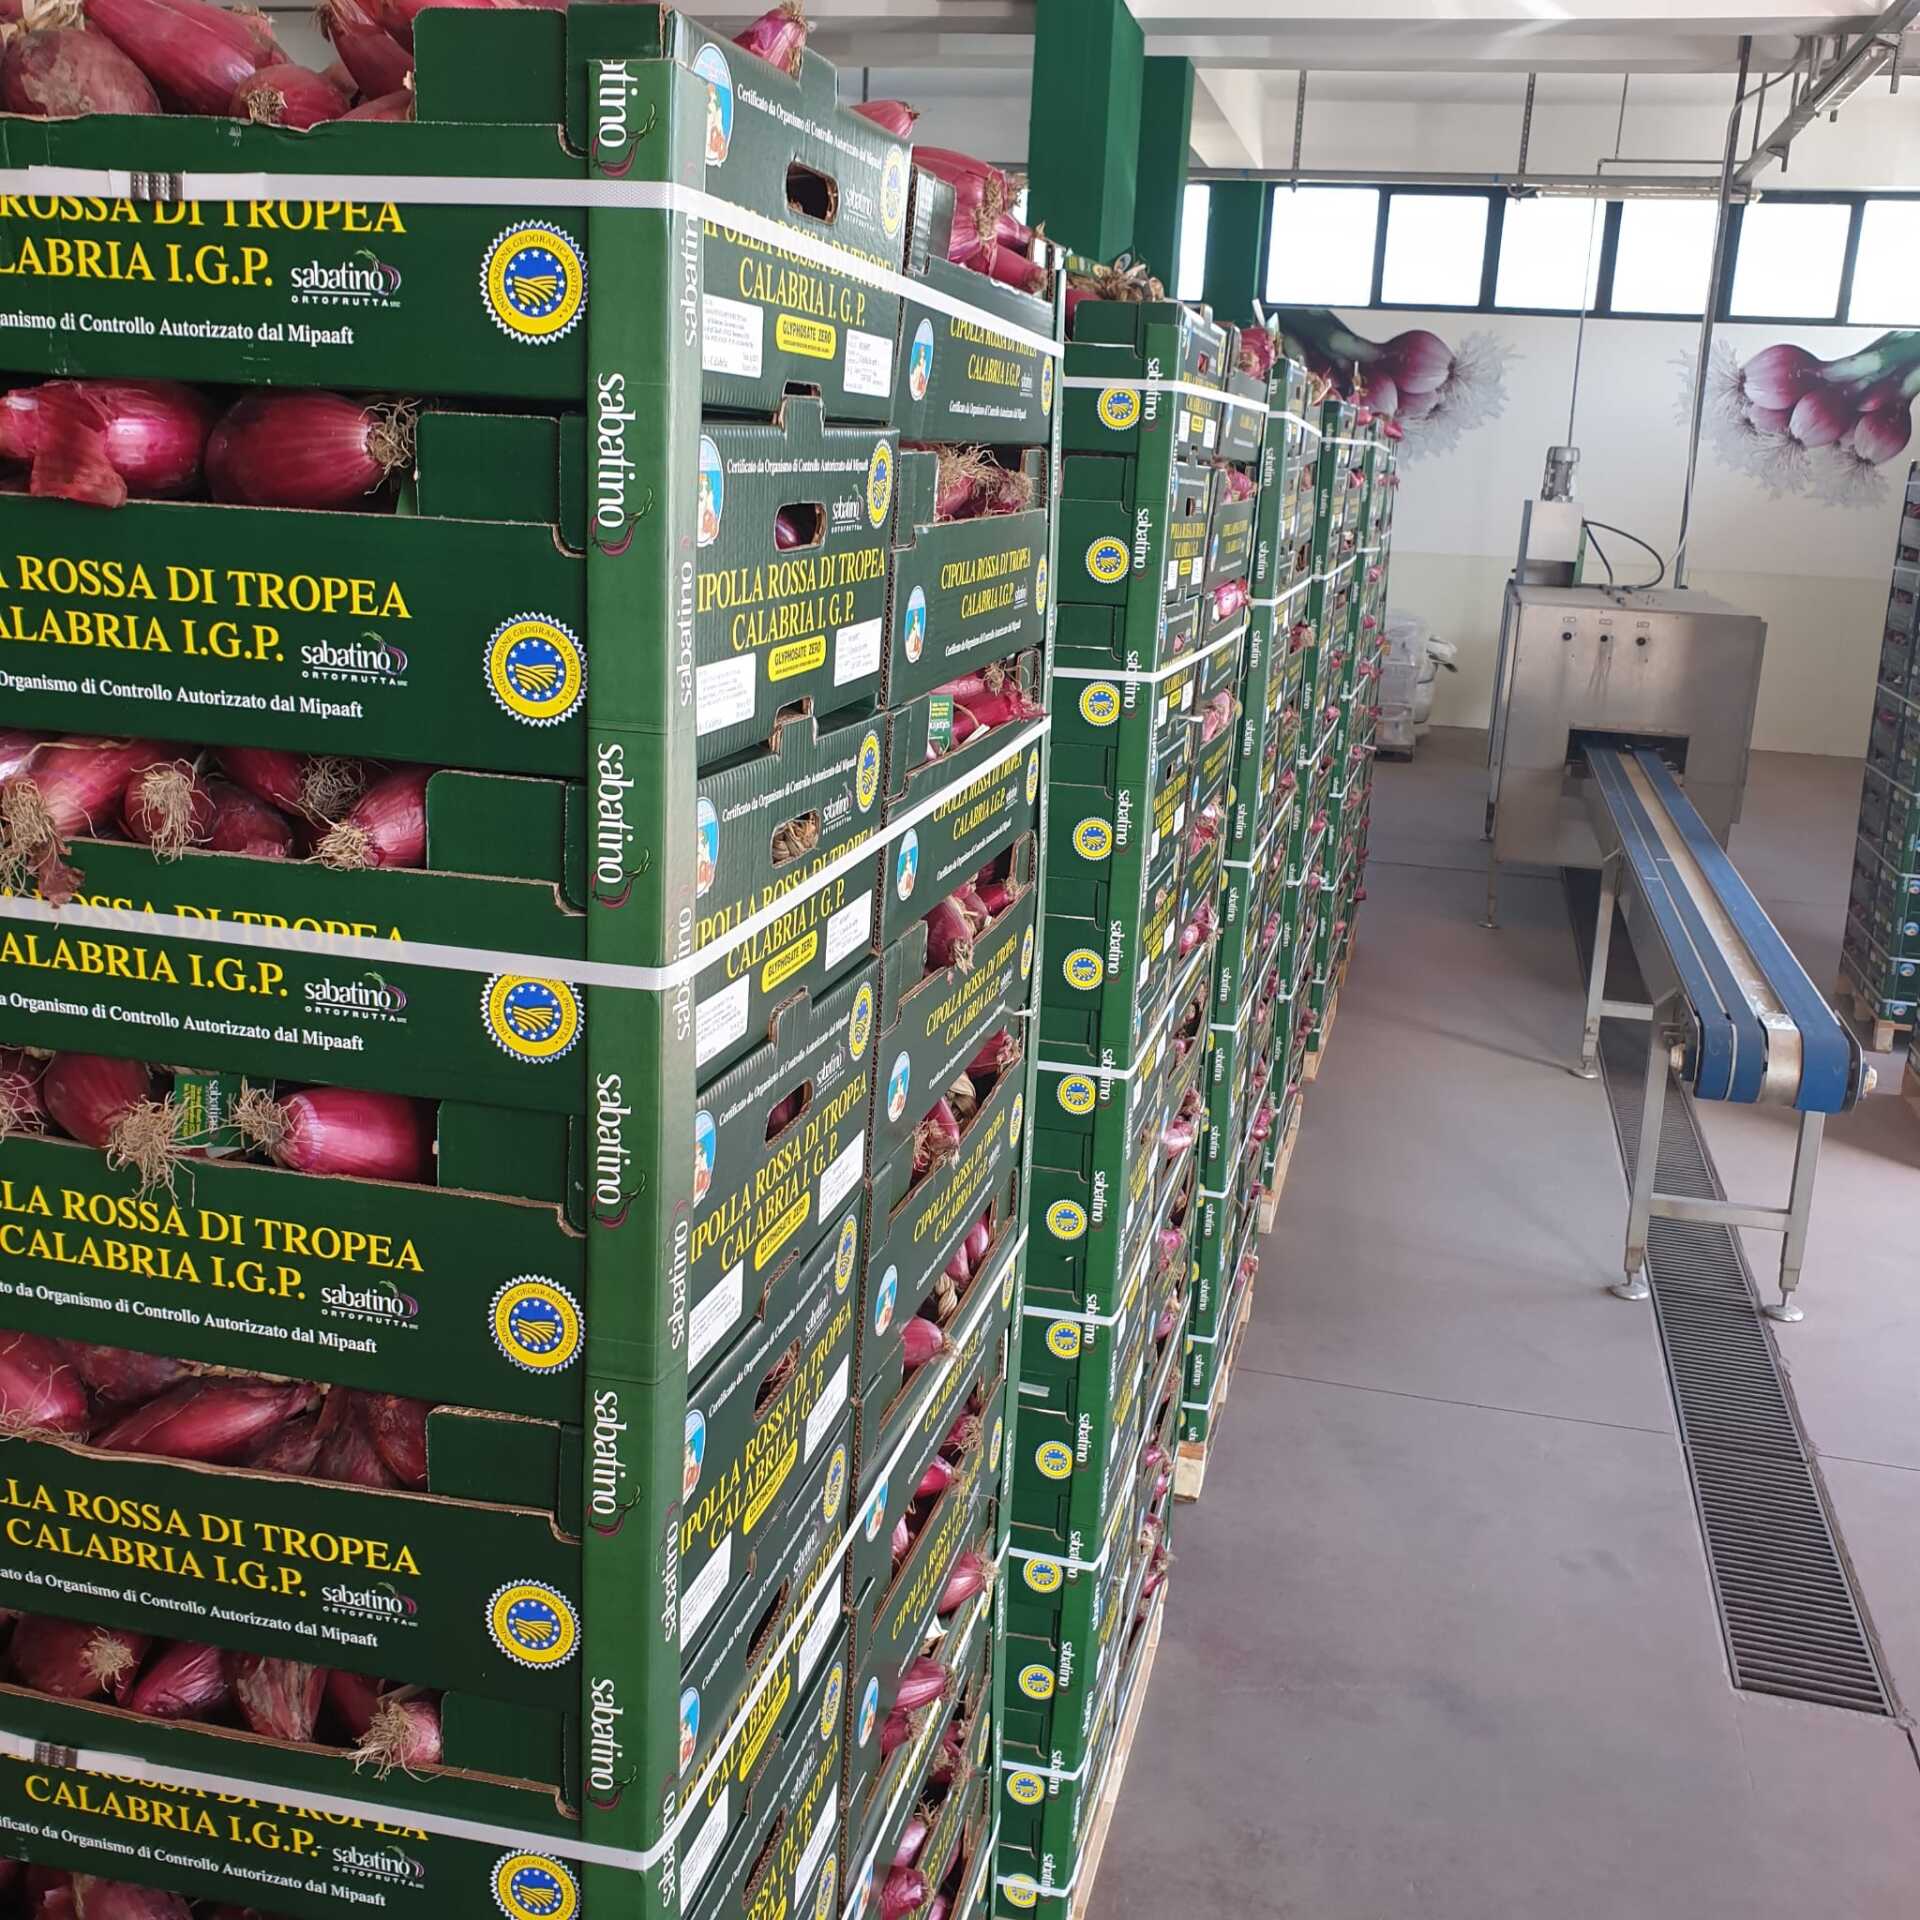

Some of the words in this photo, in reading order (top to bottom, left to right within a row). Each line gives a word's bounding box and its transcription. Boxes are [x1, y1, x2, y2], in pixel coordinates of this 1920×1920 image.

[166, 243, 274, 287] I.G.P.
[290, 260, 385, 292] sabatino
[739, 256, 825, 317] CALABRIA
[60, 312, 76, 331] di
[80, 314, 155, 336] Controllo
[159, 317, 254, 341] Autorizzato
[257, 322, 284, 342] dal
[288, 323, 354, 347] Mipaaft
[290, 295, 390, 308] ORTOFRUTTA
[782, 320, 817, 341] GLYPHOSATE
[818, 327, 832, 344] ZERO
[596, 372, 637, 529] sabatino
[726, 458, 757, 475] Certificato
[765, 459, 792, 478] Organismo
[1132, 507, 1152, 570] sabatino
[16, 554, 157, 601] ROSSA
[166, 565, 218, 605] DI
[227, 569, 413, 619] TROPEA
[767, 558, 816, 601] ROSSA
[819, 554, 837, 590] DI
[838, 547, 886, 584] TROPEA
[181, 618, 285, 662] I.G.P.
[300, 640, 391, 672] sabatino
[677, 561, 694, 708] sabatino
[731, 600, 815, 652] CALABRIA
[774, 643, 808, 668] GLYPHOSATE
[808, 640, 822, 660] ZERO
[80, 677, 97, 695] di
[99, 679, 173, 702] Controllo
[176, 686, 267, 712] Autorizzato
[270, 693, 296, 713] dal
[299, 697, 364, 720] Mipaaft
[301, 670, 397, 686] ORTOFRUTTA
[596, 742, 635, 885] sabatino
[1116, 789, 1136, 846] sabatino
[0, 930, 180, 985] ALABRIA
[188, 953, 290, 998] I.G.P.
[726, 905, 809, 980] CALABRIA
[1106, 918, 1123, 976] sabatino
[10, 992, 89, 1017] Organismo
[91, 1002, 107, 1020] di
[109, 1005, 181, 1029] Controllo
[183, 1014, 271, 1041] Autorizzato
[274, 1026, 300, 1044] dal
[301, 1029, 365, 1052] Mipaaft
[304, 977, 392, 1010] sabatino
[304, 1005, 397, 1023] ORTOFRUTTA
[596, 1072, 632, 1206] sabatino
[755, 1135, 802, 1199] ROSSA
[805, 1118, 820, 1155] DI
[821, 1070, 868, 1137] TROPEA
[0, 1178, 53, 1218] LA
[61, 1188, 191, 1239] ROSSA
[198, 1208, 247, 1247] DI
[254, 1217, 426, 1273] TROPEA
[721, 1171, 801, 1271] CALABRIA
[1091, 1169, 1107, 1224] sabatino
[0, 1224, 202, 1285] CALABRIA
[210, 1255, 308, 1301] I.G.P.
[667, 1220, 689, 1352] sabatino
[15, 1282, 35, 1299] da
[35, 1285, 113, 1311] Organismo
[115, 1296, 131, 1314] di
[132, 1300, 201, 1326] Controllo
[203, 1312, 289, 1340] Autorizzato
[291, 1325, 316, 1344] dal
[318, 1330, 378, 1354] Mipaaft
[320, 1283, 404, 1318] sabatino
[321, 1308, 410, 1330] ORTOFRUTTA
[744, 1399, 792, 1473] ROSSA
[793, 1374, 809, 1414] DI
[810, 1300, 853, 1381] TROPEA
[592, 1389, 628, 1515] sabatino
[1075, 1412, 1091, 1464] sabatino
[709, 1433, 788, 1551] CALABRIA
[0, 1478, 57, 1514] LA
[64, 1488, 194, 1539] ROSSA
[200, 1512, 249, 1549] DI
[254, 1522, 423, 1577] TROPEA
[6, 1517, 206, 1580] CALABRIA
[213, 1554, 309, 1599] I.G.P.
[660, 1520, 679, 1643] sabatino
[25, 1570, 43, 1586] da
[45, 1574, 121, 1602] Organismo
[123, 1586, 139, 1604] di
[140, 1591, 207, 1617] Controllo
[210, 1604, 293, 1633] Autorizzato
[295, 1619, 319, 1638] dal
[321, 1623, 380, 1649] Mipaaft
[321, 1582, 404, 1617] sabatino
[322, 1604, 409, 1627] ORTOFRUTTA
[590, 1676, 625, 1791] sabatino
[24, 1774, 220, 1839] CALABRIA
[227, 1815, 319, 1859] I.G.P.
[41, 1823, 60, 1841] da
[61, 1827, 136, 1859] Organismo
[137, 1843, 153, 1861] di
[154, 1847, 220, 1874] Controllo
[222, 1861, 303, 1890] Autorizzato
[305, 1877, 328, 1896] dal
[330, 1879, 386, 1908] Mipaaft
[332, 1845, 412, 1878] sabatino
